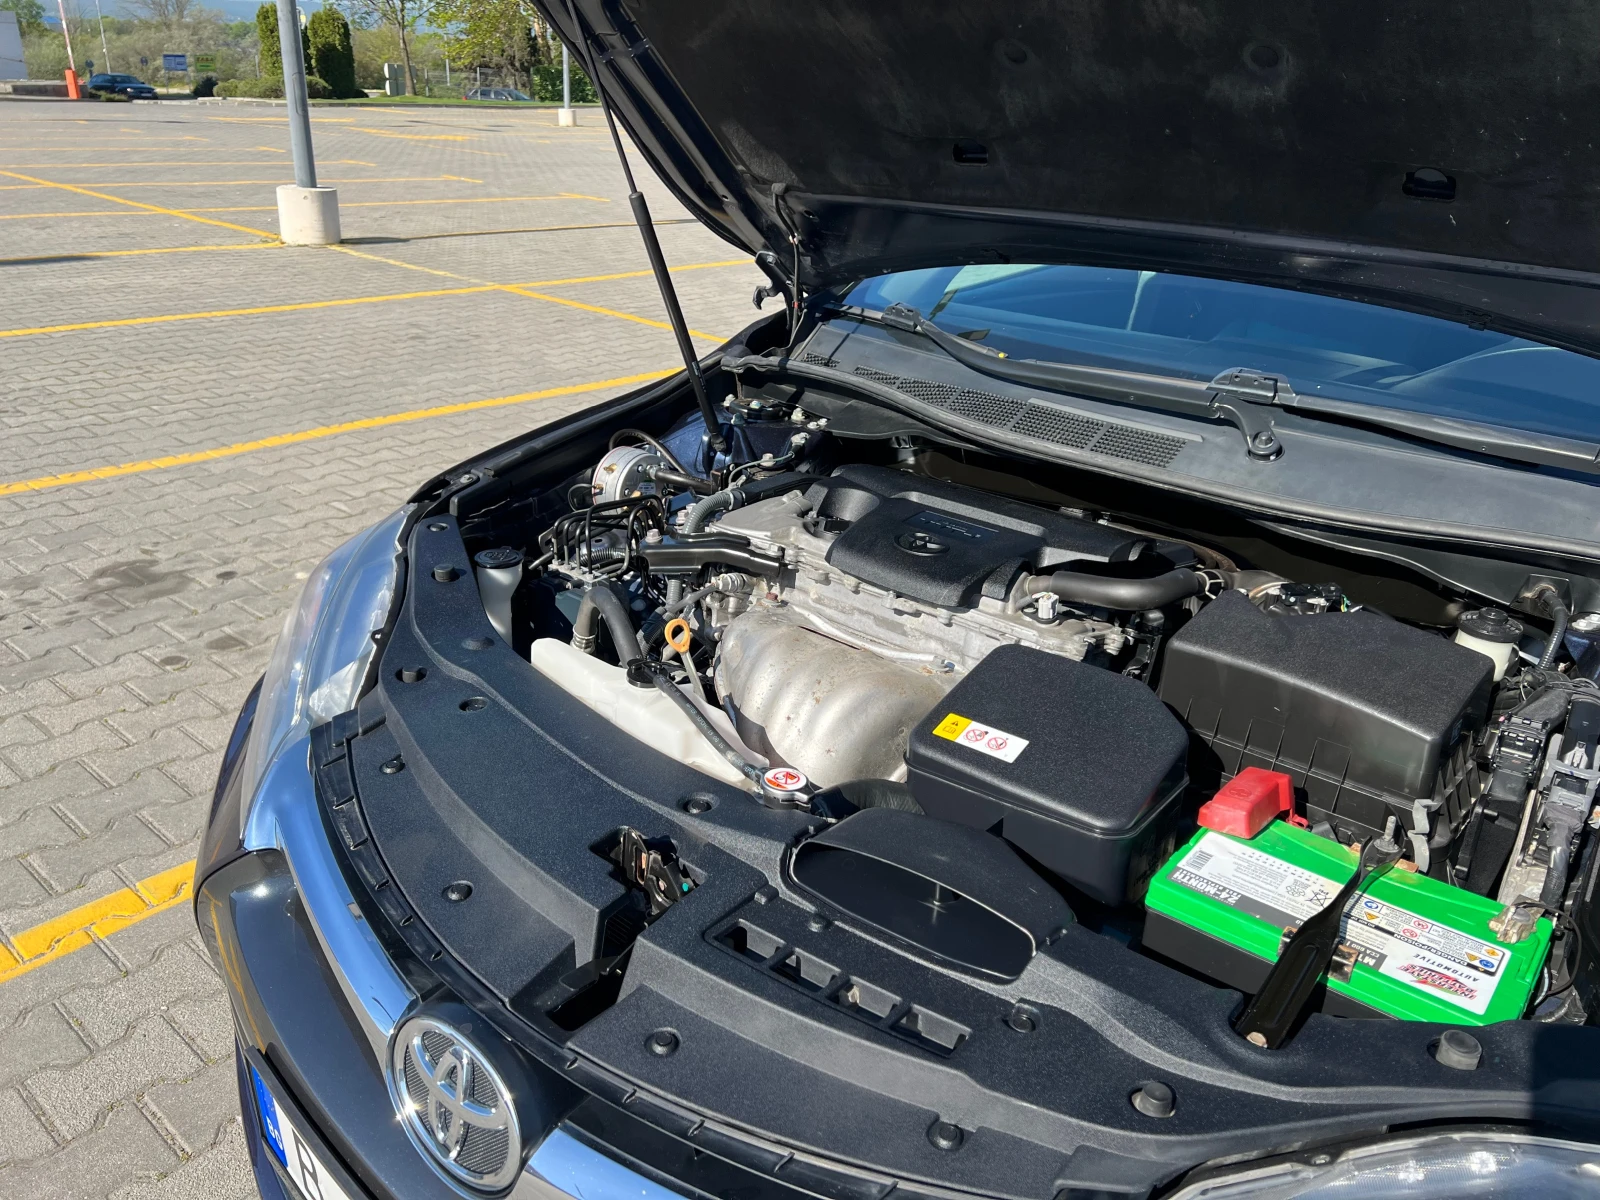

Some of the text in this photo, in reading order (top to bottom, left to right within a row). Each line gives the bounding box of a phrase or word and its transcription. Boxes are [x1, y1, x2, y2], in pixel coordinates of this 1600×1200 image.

[1171, 870, 1240, 903] 24-MONTH
[1177, 868, 1242, 898] FREE REPLACEMENT
[1365, 948, 1379, 958] CCA
[1392, 932, 1468, 966] DANGER/POISON
[1397, 963, 1476, 1001] INTERSTATE
[1406, 962, 1476, 995] BATTERIES
[1412, 951, 1479, 984] AUTOMOTIVE
[266, 1116, 284, 1151] BG
